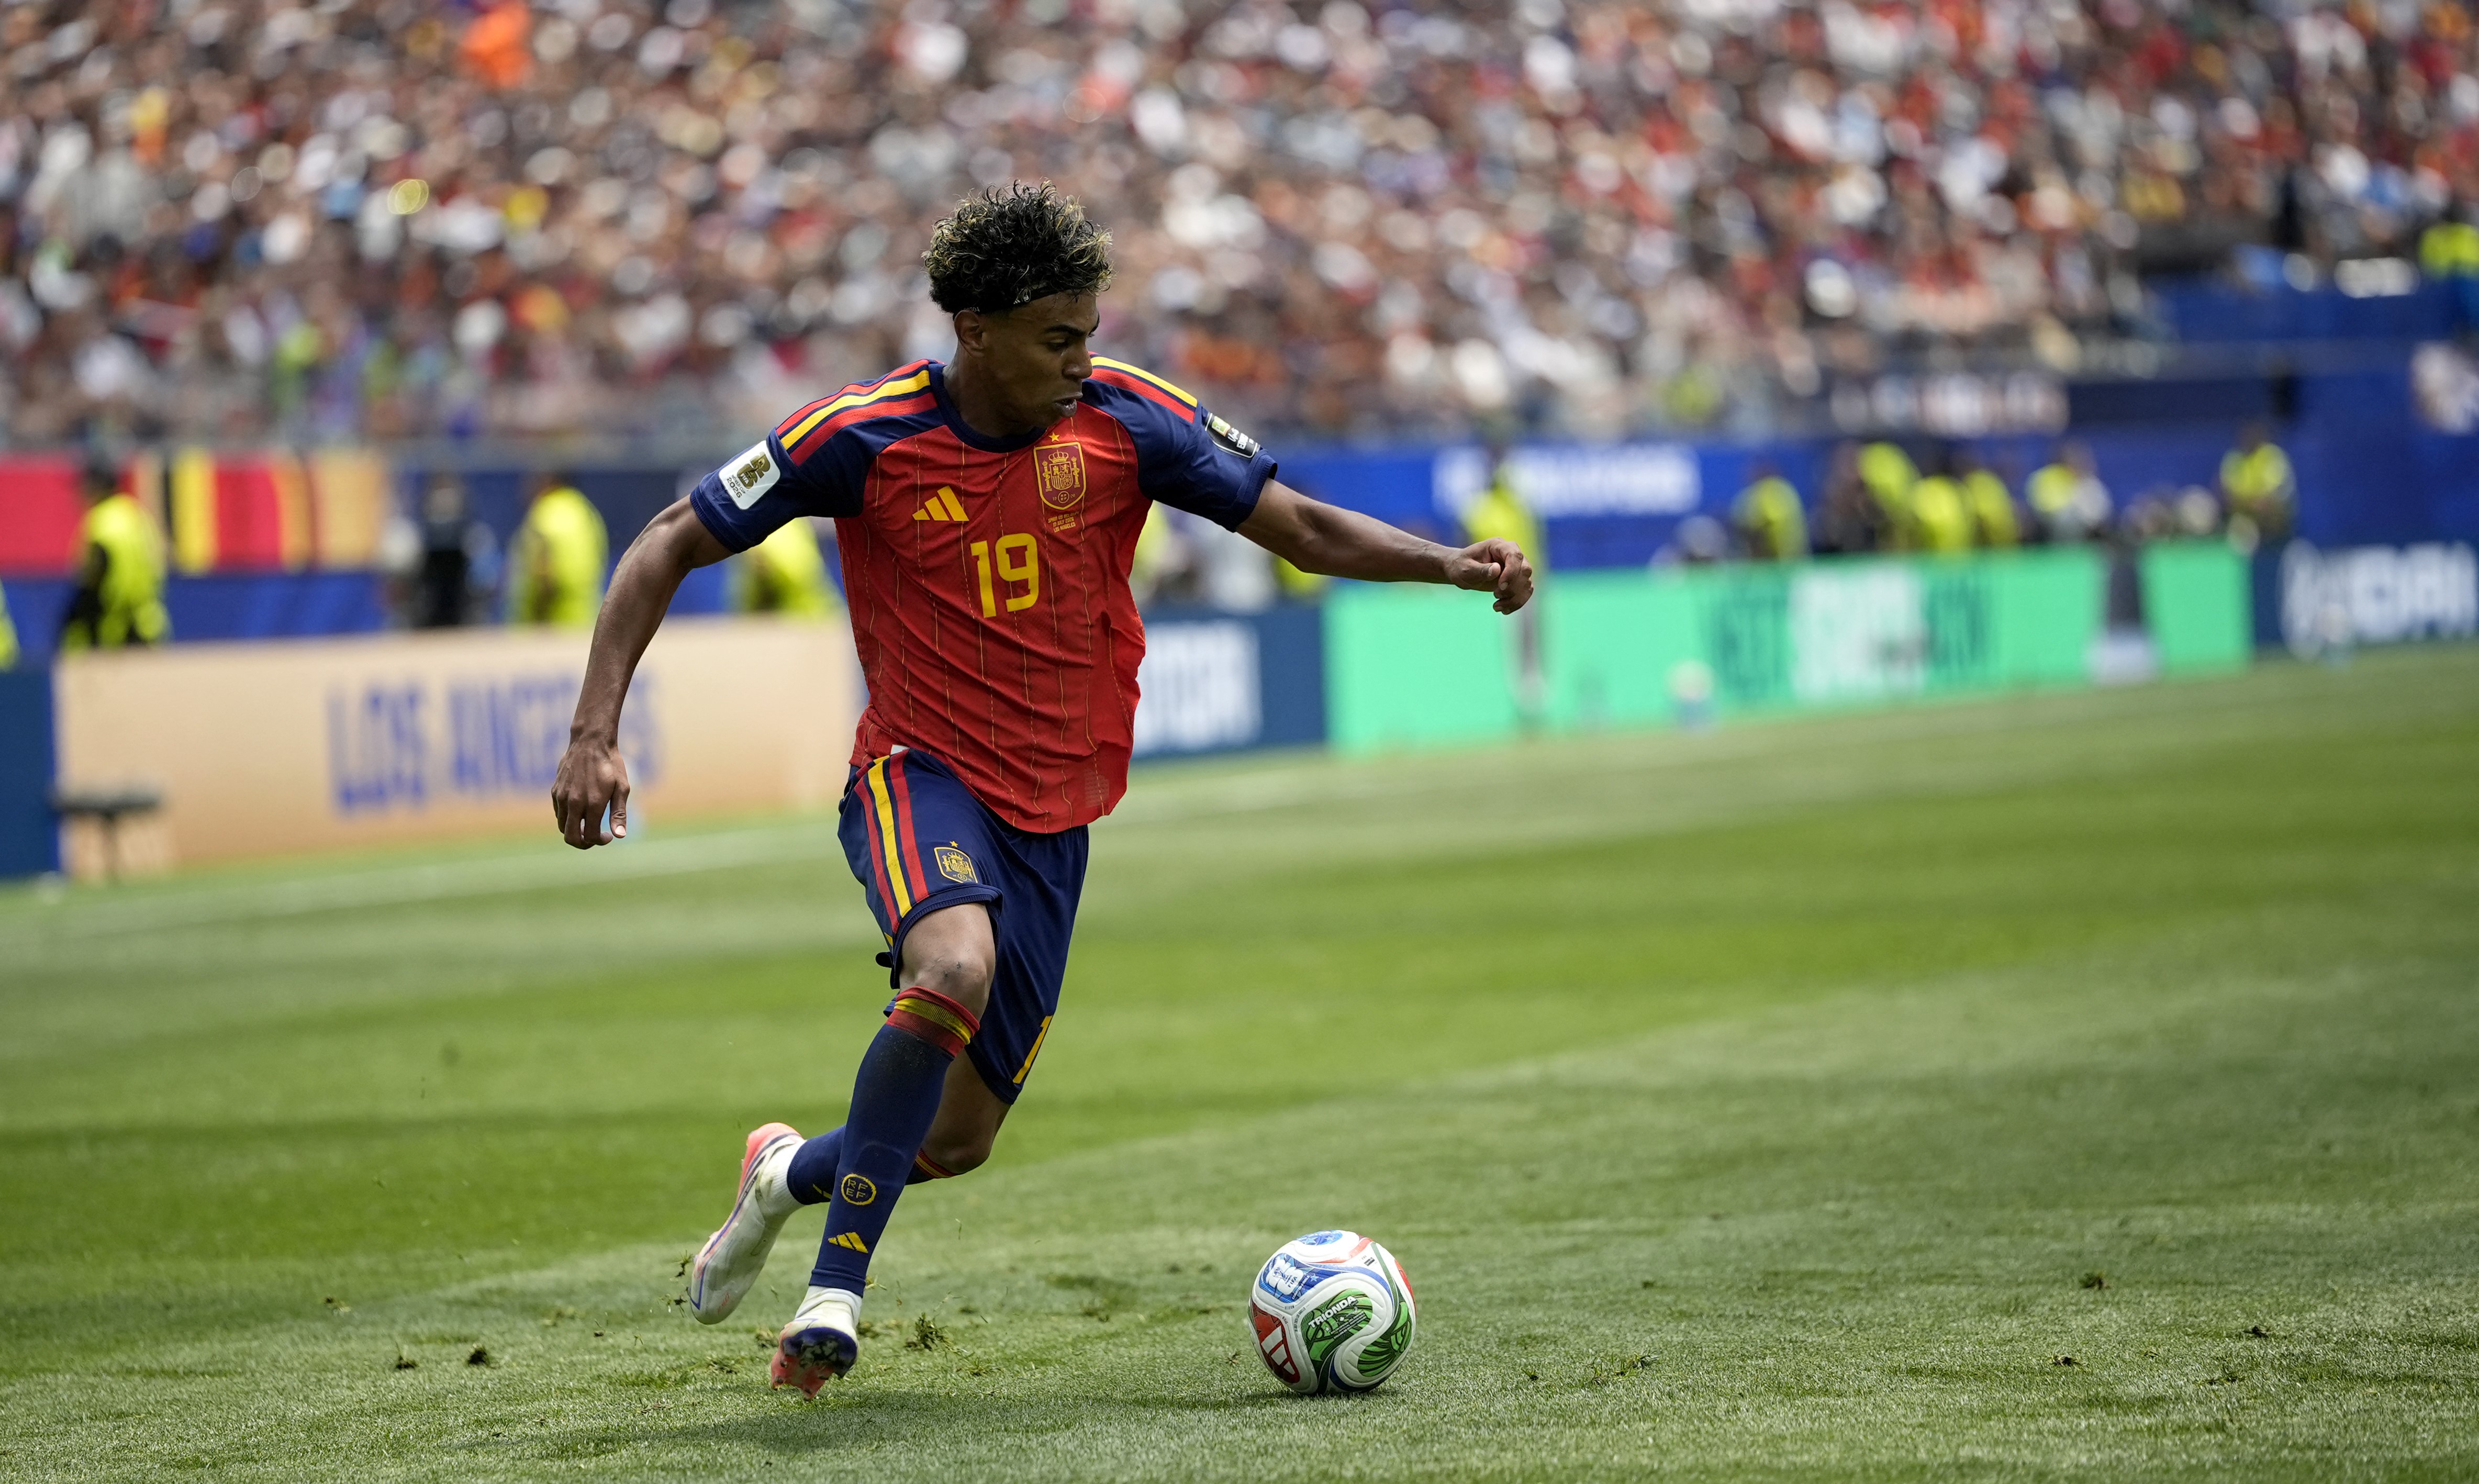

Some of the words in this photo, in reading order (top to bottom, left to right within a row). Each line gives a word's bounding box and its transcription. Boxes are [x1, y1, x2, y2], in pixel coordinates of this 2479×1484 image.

[727, 477, 742, 498] 2026
[740, 473, 749, 485] FIFA
[970, 533, 1039, 618] 19
[326, 682, 425, 815] LOS
[449, 672, 661, 798] ANGES
[1288, 1276, 1297, 1288] FIFA
[1308, 1295, 1357, 1329] TRIONDA
